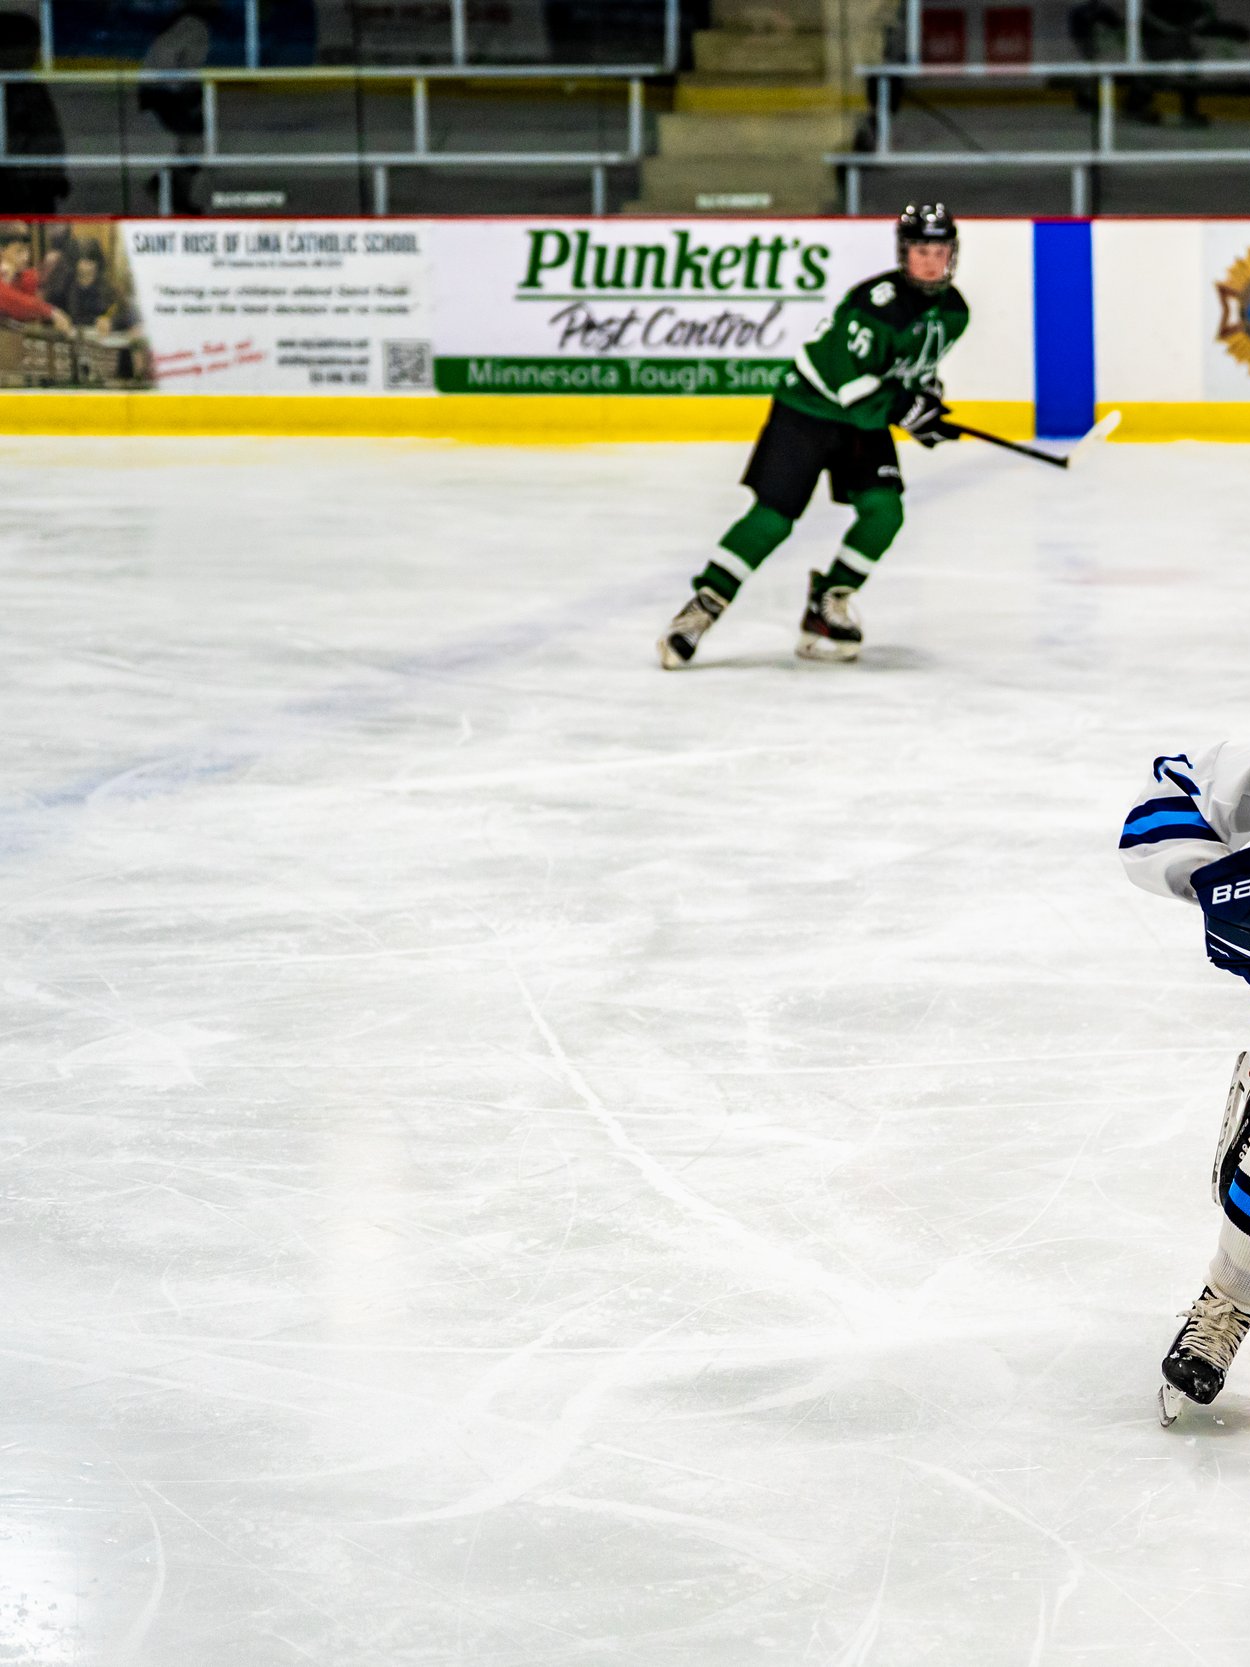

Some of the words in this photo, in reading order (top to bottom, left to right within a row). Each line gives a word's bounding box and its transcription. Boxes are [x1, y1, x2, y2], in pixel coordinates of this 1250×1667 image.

[136, 234, 175, 253] SAINT
[182, 234, 217, 253] ROSE
[225, 234, 239, 253] OF
[248, 233, 281, 253] LIMA
[289, 234, 357, 253] CATHOLIC
[365, 233, 420, 253] SCHOOL
[518, 229, 831, 290] Plunkett's
[549, 301, 640, 352] Pest
[641, 301, 787, 351] Control
[467, 360, 618, 388] Minnesota
[628, 360, 717, 394] Tough
[726, 360, 783, 388] Sinc
